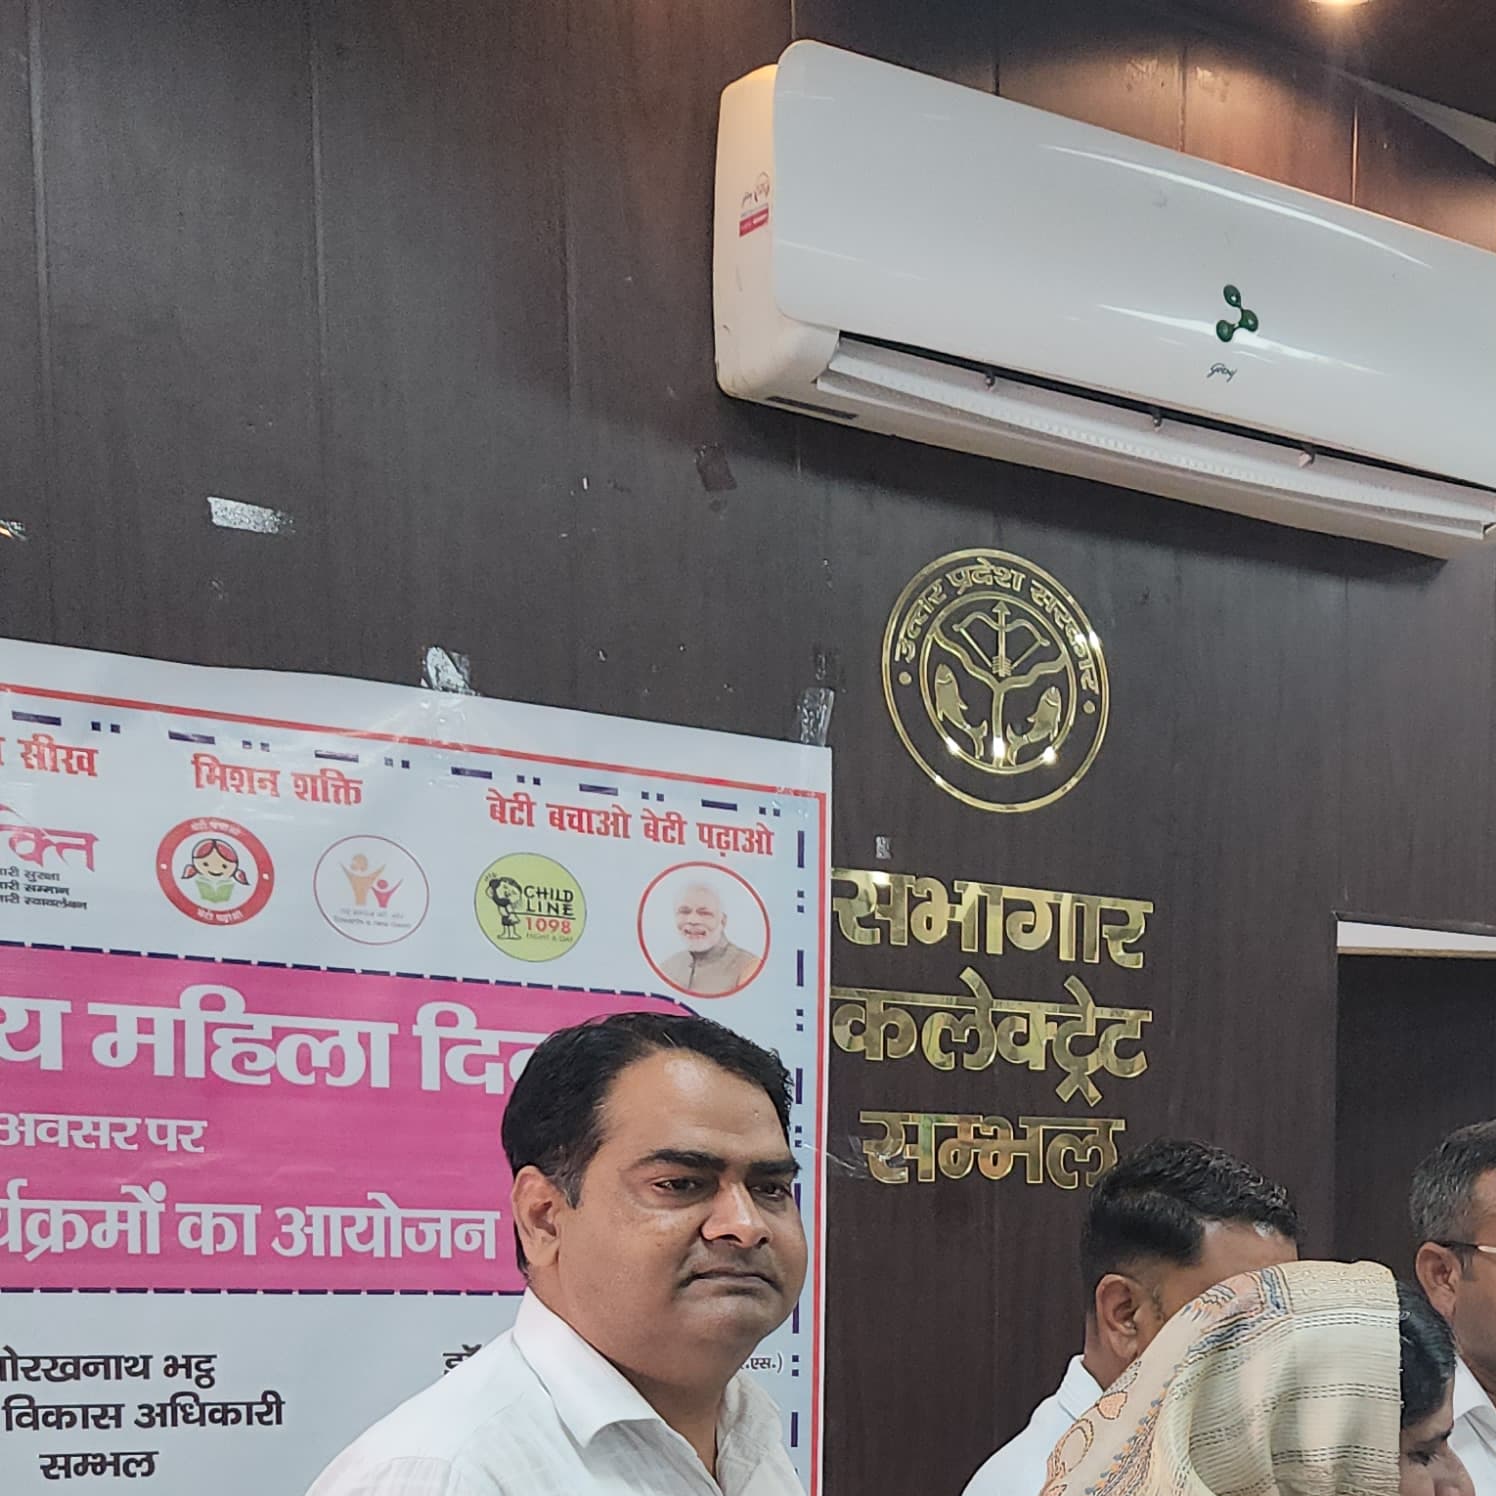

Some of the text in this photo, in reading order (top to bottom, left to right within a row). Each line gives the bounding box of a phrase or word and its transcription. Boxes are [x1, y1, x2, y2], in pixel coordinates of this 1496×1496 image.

[945, 556, 1026, 595] प्रदेश
[191, 753, 363, 806] मिशन शक्ति
[486, 787, 774, 857] बेटी बचाओ बेटी पढ़ाओ
[524, 885, 574, 902] CHILD
[527, 900, 574, 916] LINE
[526, 917, 571, 934] 1098
[831, 867, 1153, 968] सभागार
[88, 984, 398, 1088] महिला
[830, 966, 1152, 1107] कलेक्ट्रेट
[0, 1111, 207, 1152] अवसर पर
[860, 1111, 1126, 1190] सम्भल
[176, 1203, 261, 1256] का
[271, 1192, 500, 1260] आयोजन
[2, 1390, 286, 1431] विकास अधिकारी
[39, 1451, 159, 1480] सम्भल
